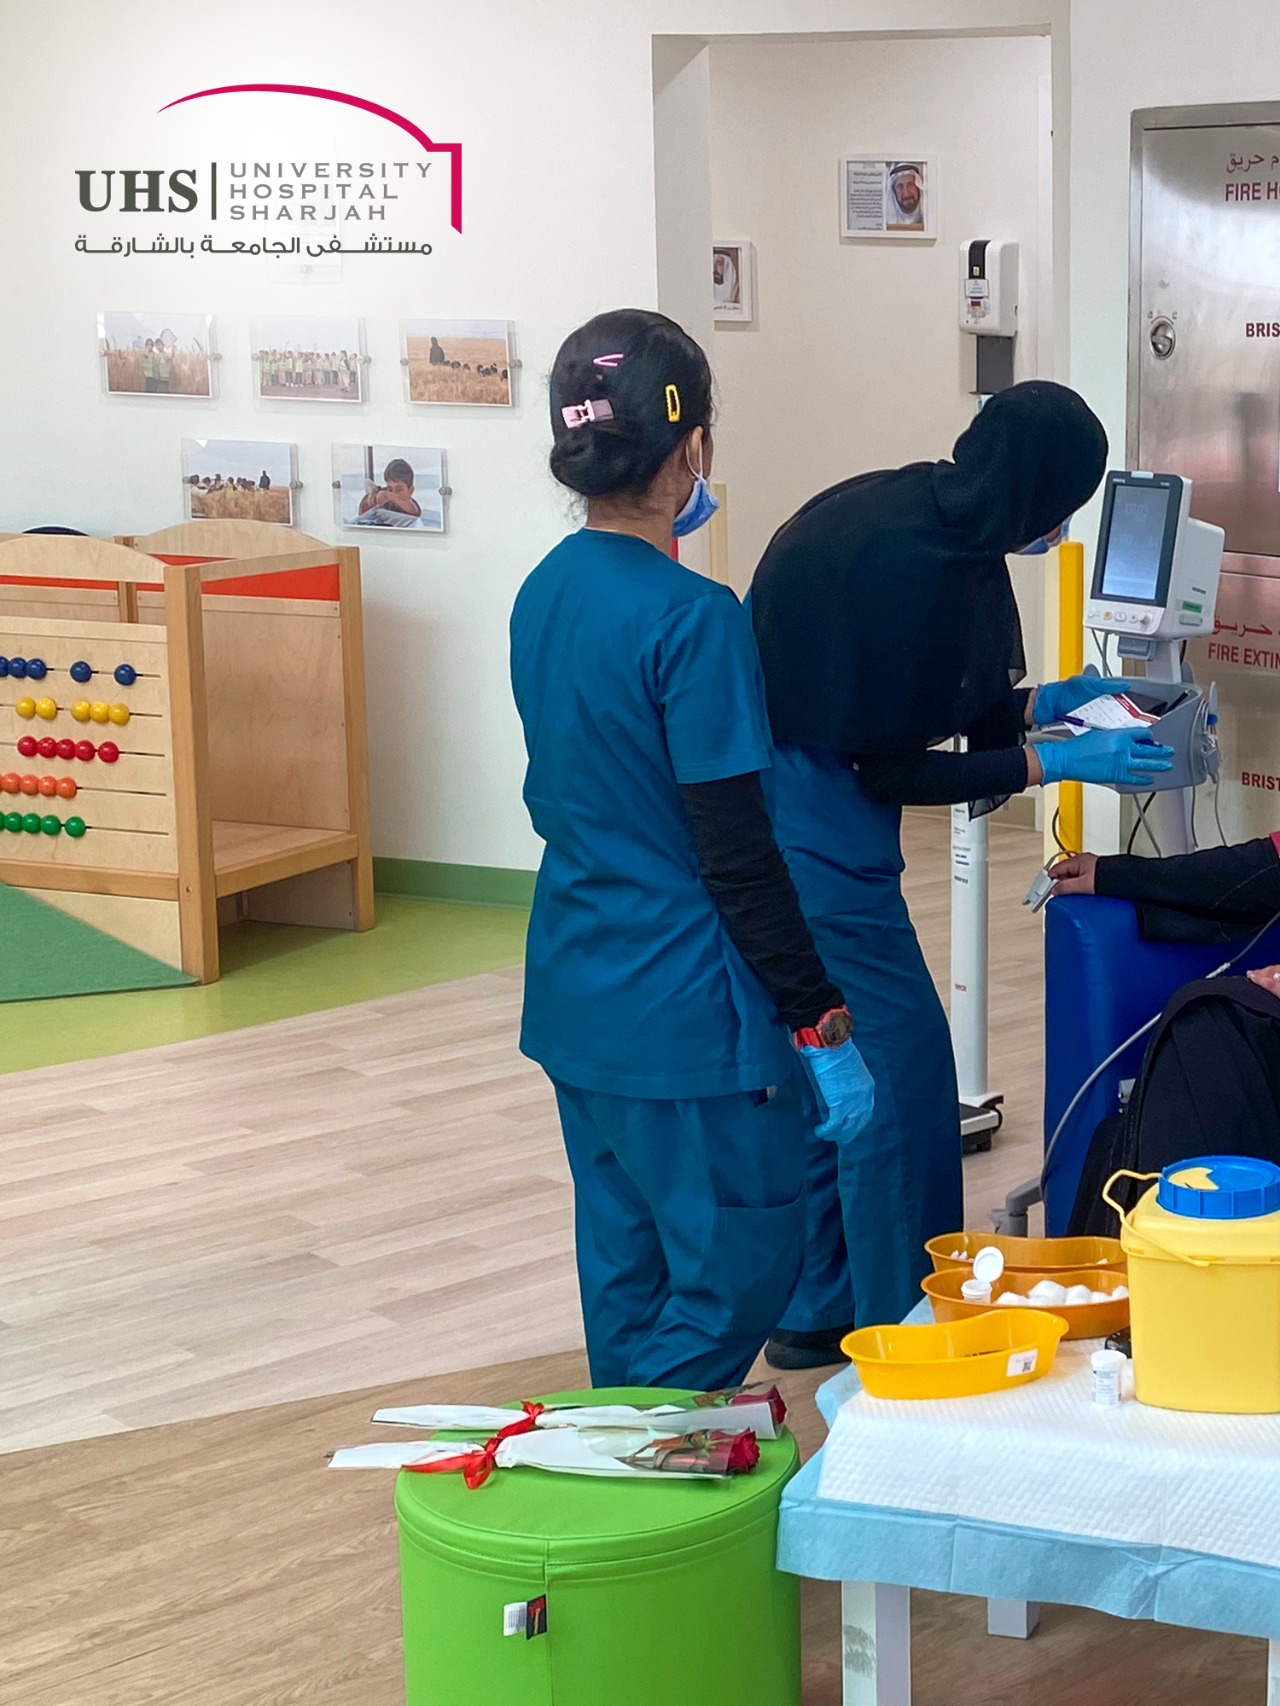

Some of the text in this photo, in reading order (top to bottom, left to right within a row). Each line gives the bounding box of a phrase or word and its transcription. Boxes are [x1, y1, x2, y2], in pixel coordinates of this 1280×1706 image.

[1226, 153, 1265, 173] حريق
[1225, 182, 1261, 201] FIRE
[1212, 615, 1273, 638] حريق
[1207, 642, 1239, 664] FIRE
